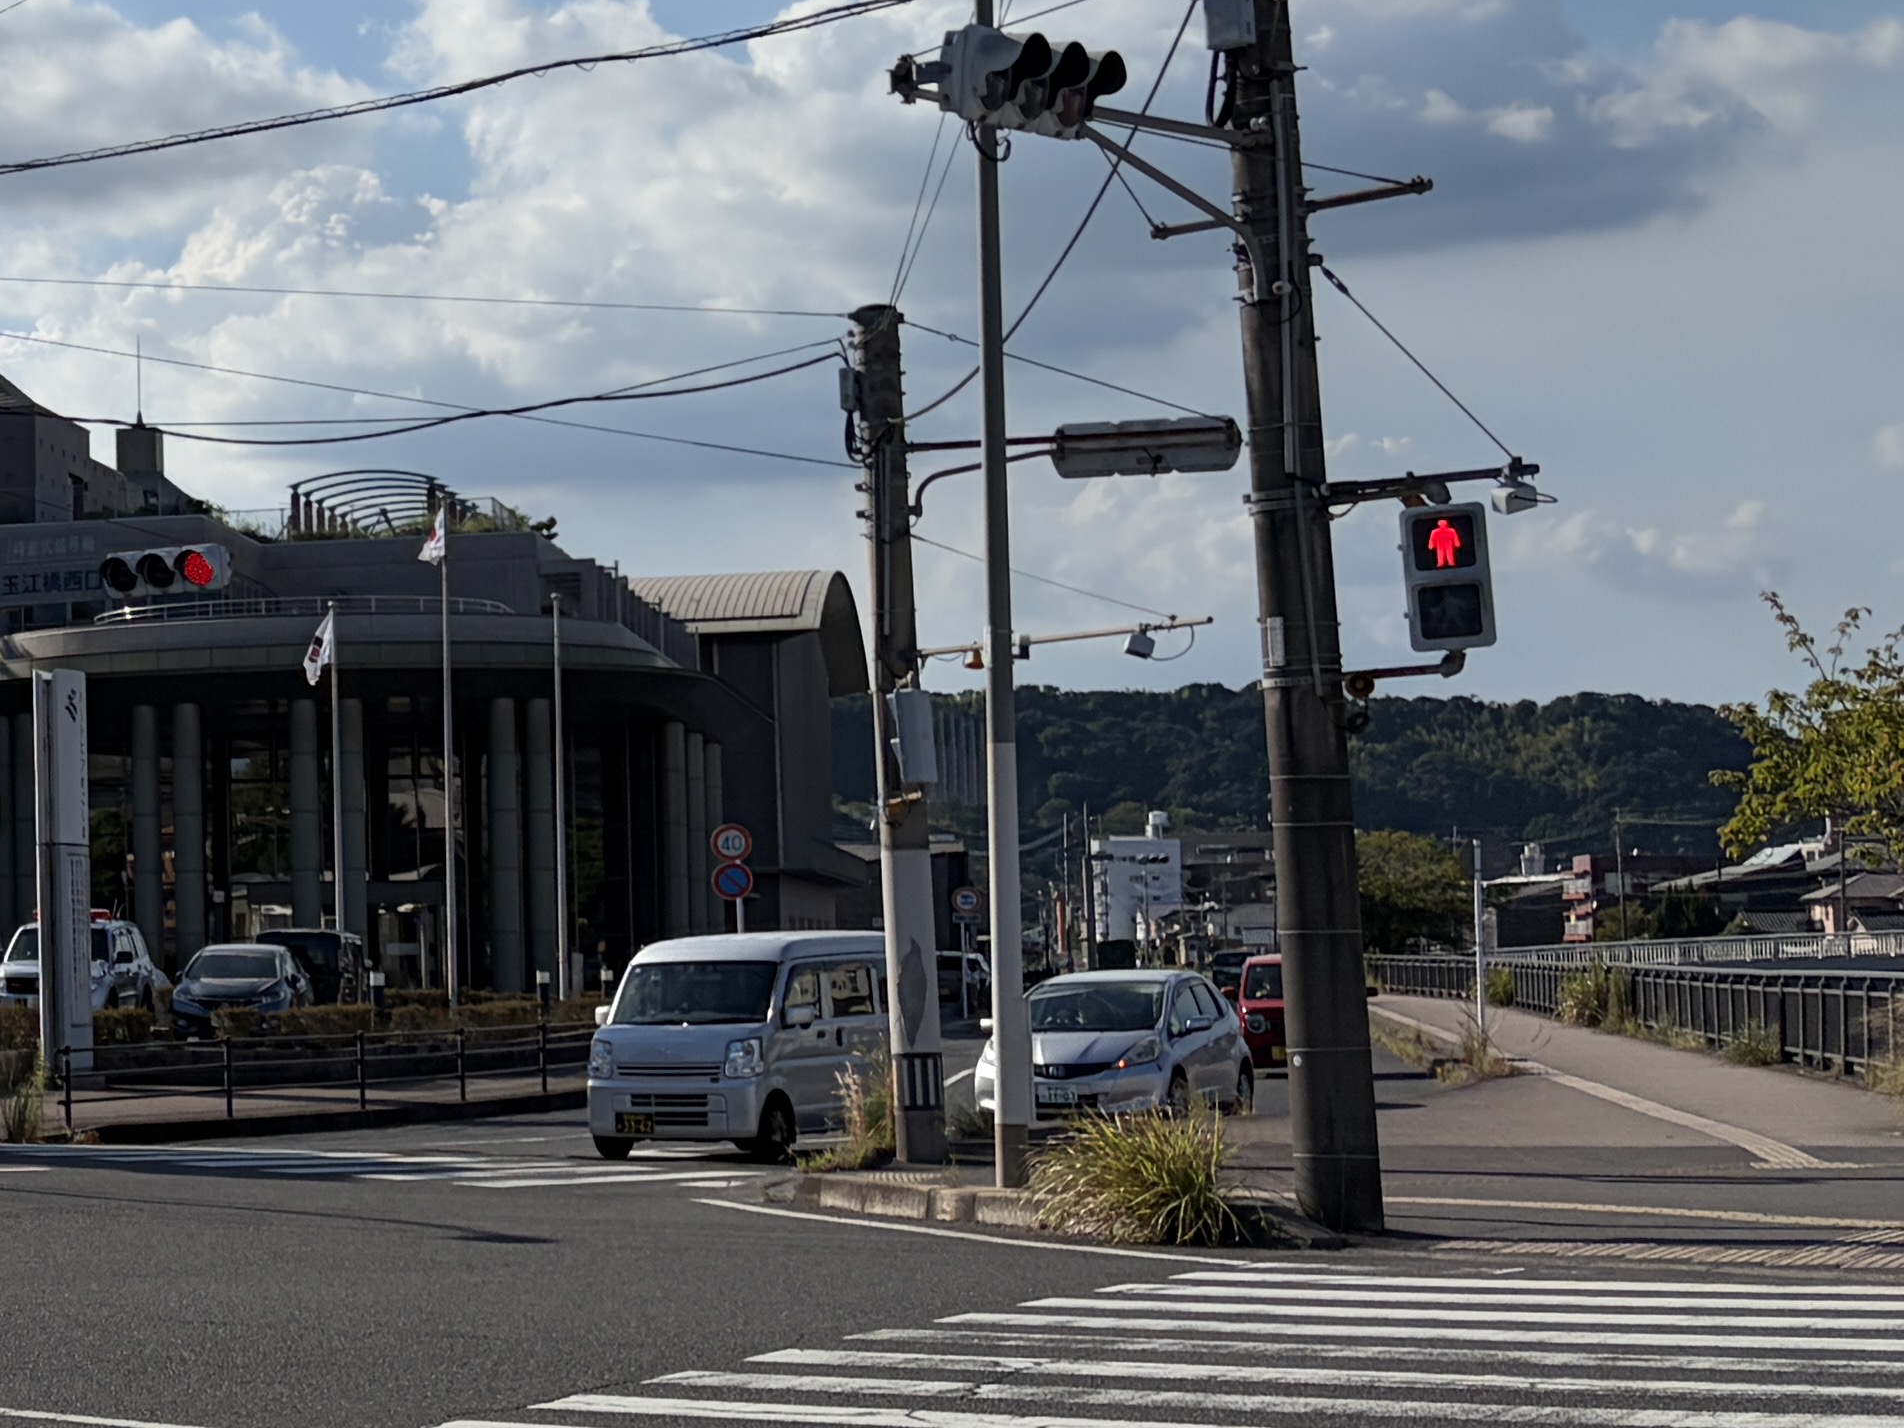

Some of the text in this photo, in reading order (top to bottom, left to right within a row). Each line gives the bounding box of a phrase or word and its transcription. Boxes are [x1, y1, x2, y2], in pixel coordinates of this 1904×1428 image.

[1, 569, 101, 594] 玉江橋西口
[722, 835, 742, 850] 40
